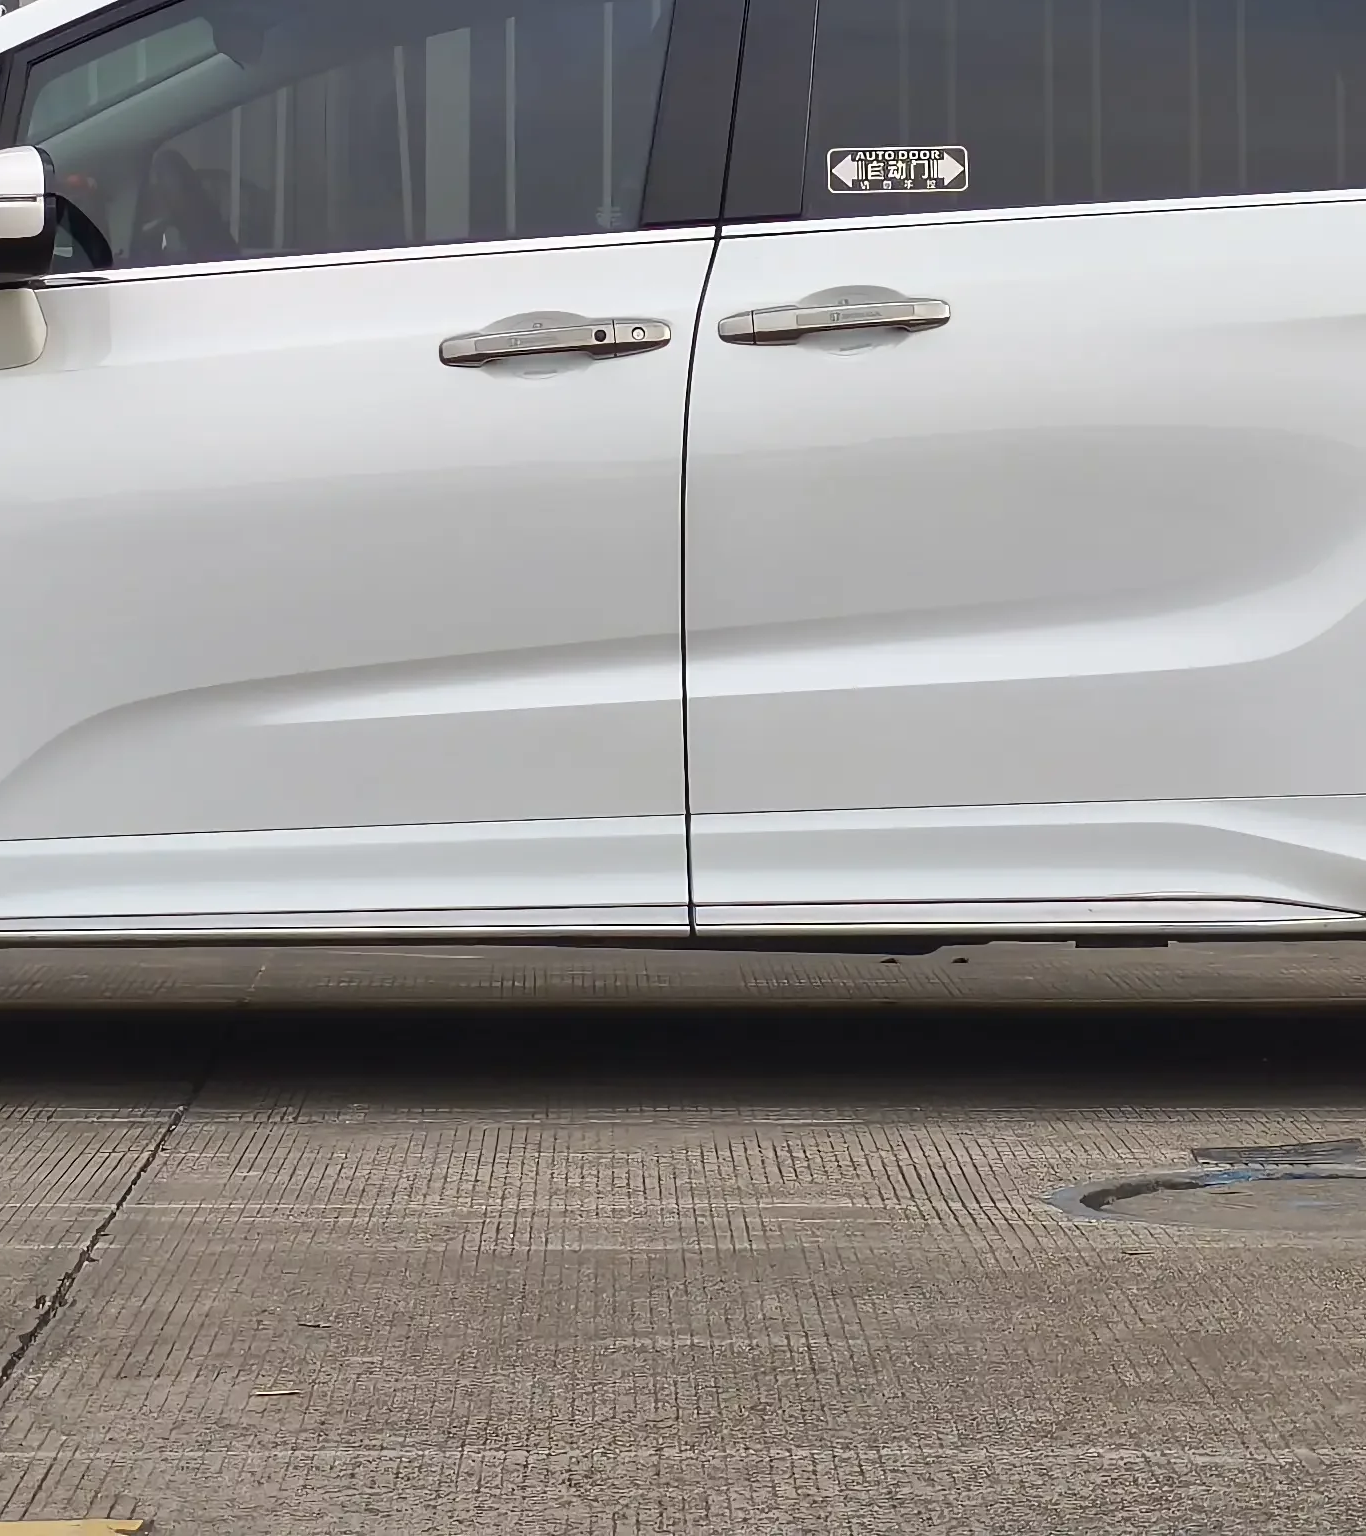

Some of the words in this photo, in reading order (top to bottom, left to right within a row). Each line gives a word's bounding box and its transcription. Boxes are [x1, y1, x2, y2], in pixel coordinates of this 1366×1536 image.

[856, 151, 895, 161] AUTO
[898, 150, 940, 160] DOOR
[867, 160, 929, 180] 自动门
